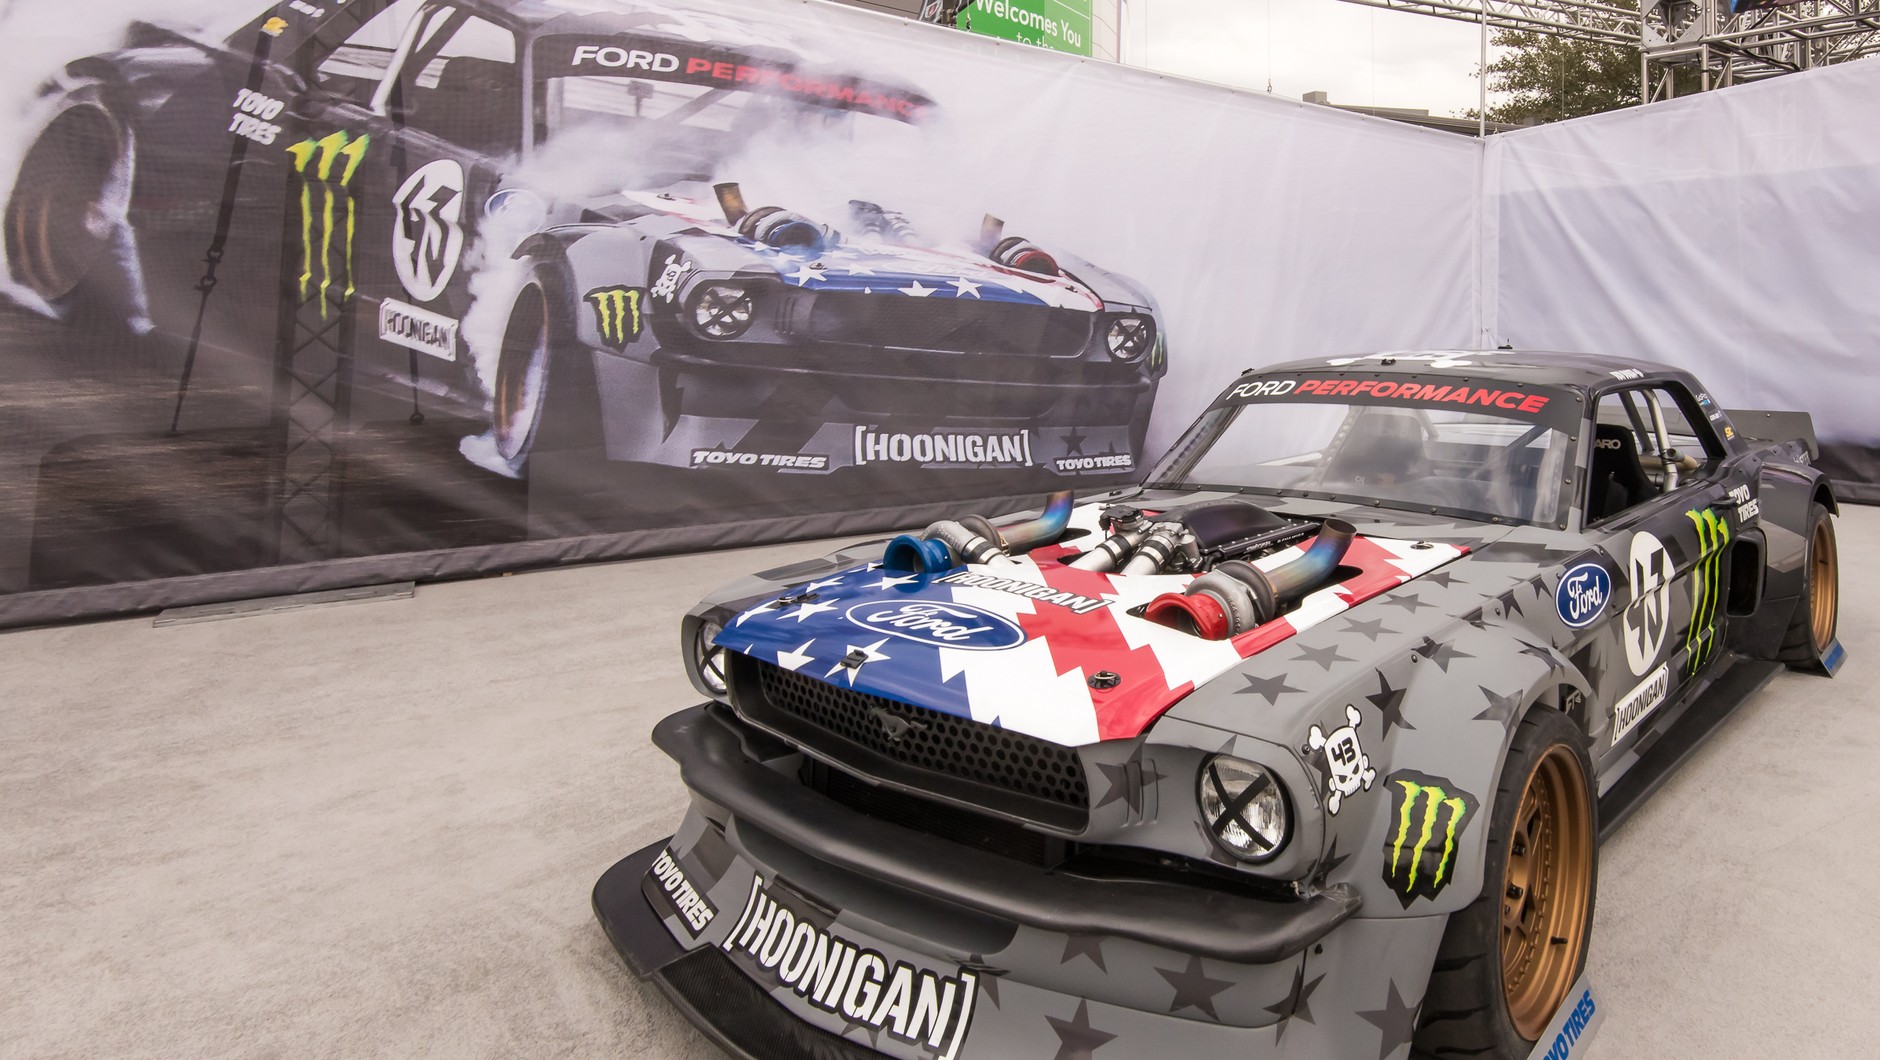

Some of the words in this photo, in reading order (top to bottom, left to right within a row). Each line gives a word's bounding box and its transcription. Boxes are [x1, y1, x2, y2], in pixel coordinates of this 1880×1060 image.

[974, 0, 1058, 37] Welcomes
[1060, 19, 1081, 48] You
[571, 45, 680, 73] FORD
[685, 57, 929, 121] PERORMANC
[232, 88, 285, 120] TOYO
[1226, 380, 1296, 401] FORD
[1293, 380, 1550, 414] PERFORMANCE
[692, 451, 758, 465] TOYO
[759, 453, 829, 469] TIRES
[1056, 457, 1094, 470] TOYO
[1093, 454, 1132, 468] TIRES
[1567, 571, 1603, 620] Ford
[866, 603, 995, 642] Ford
[1331, 736, 1356, 767] 43
[651, 849, 684, 892] TOYO
[671, 879, 715, 931] TIRES
[1562, 989, 1596, 1048] TIRES
